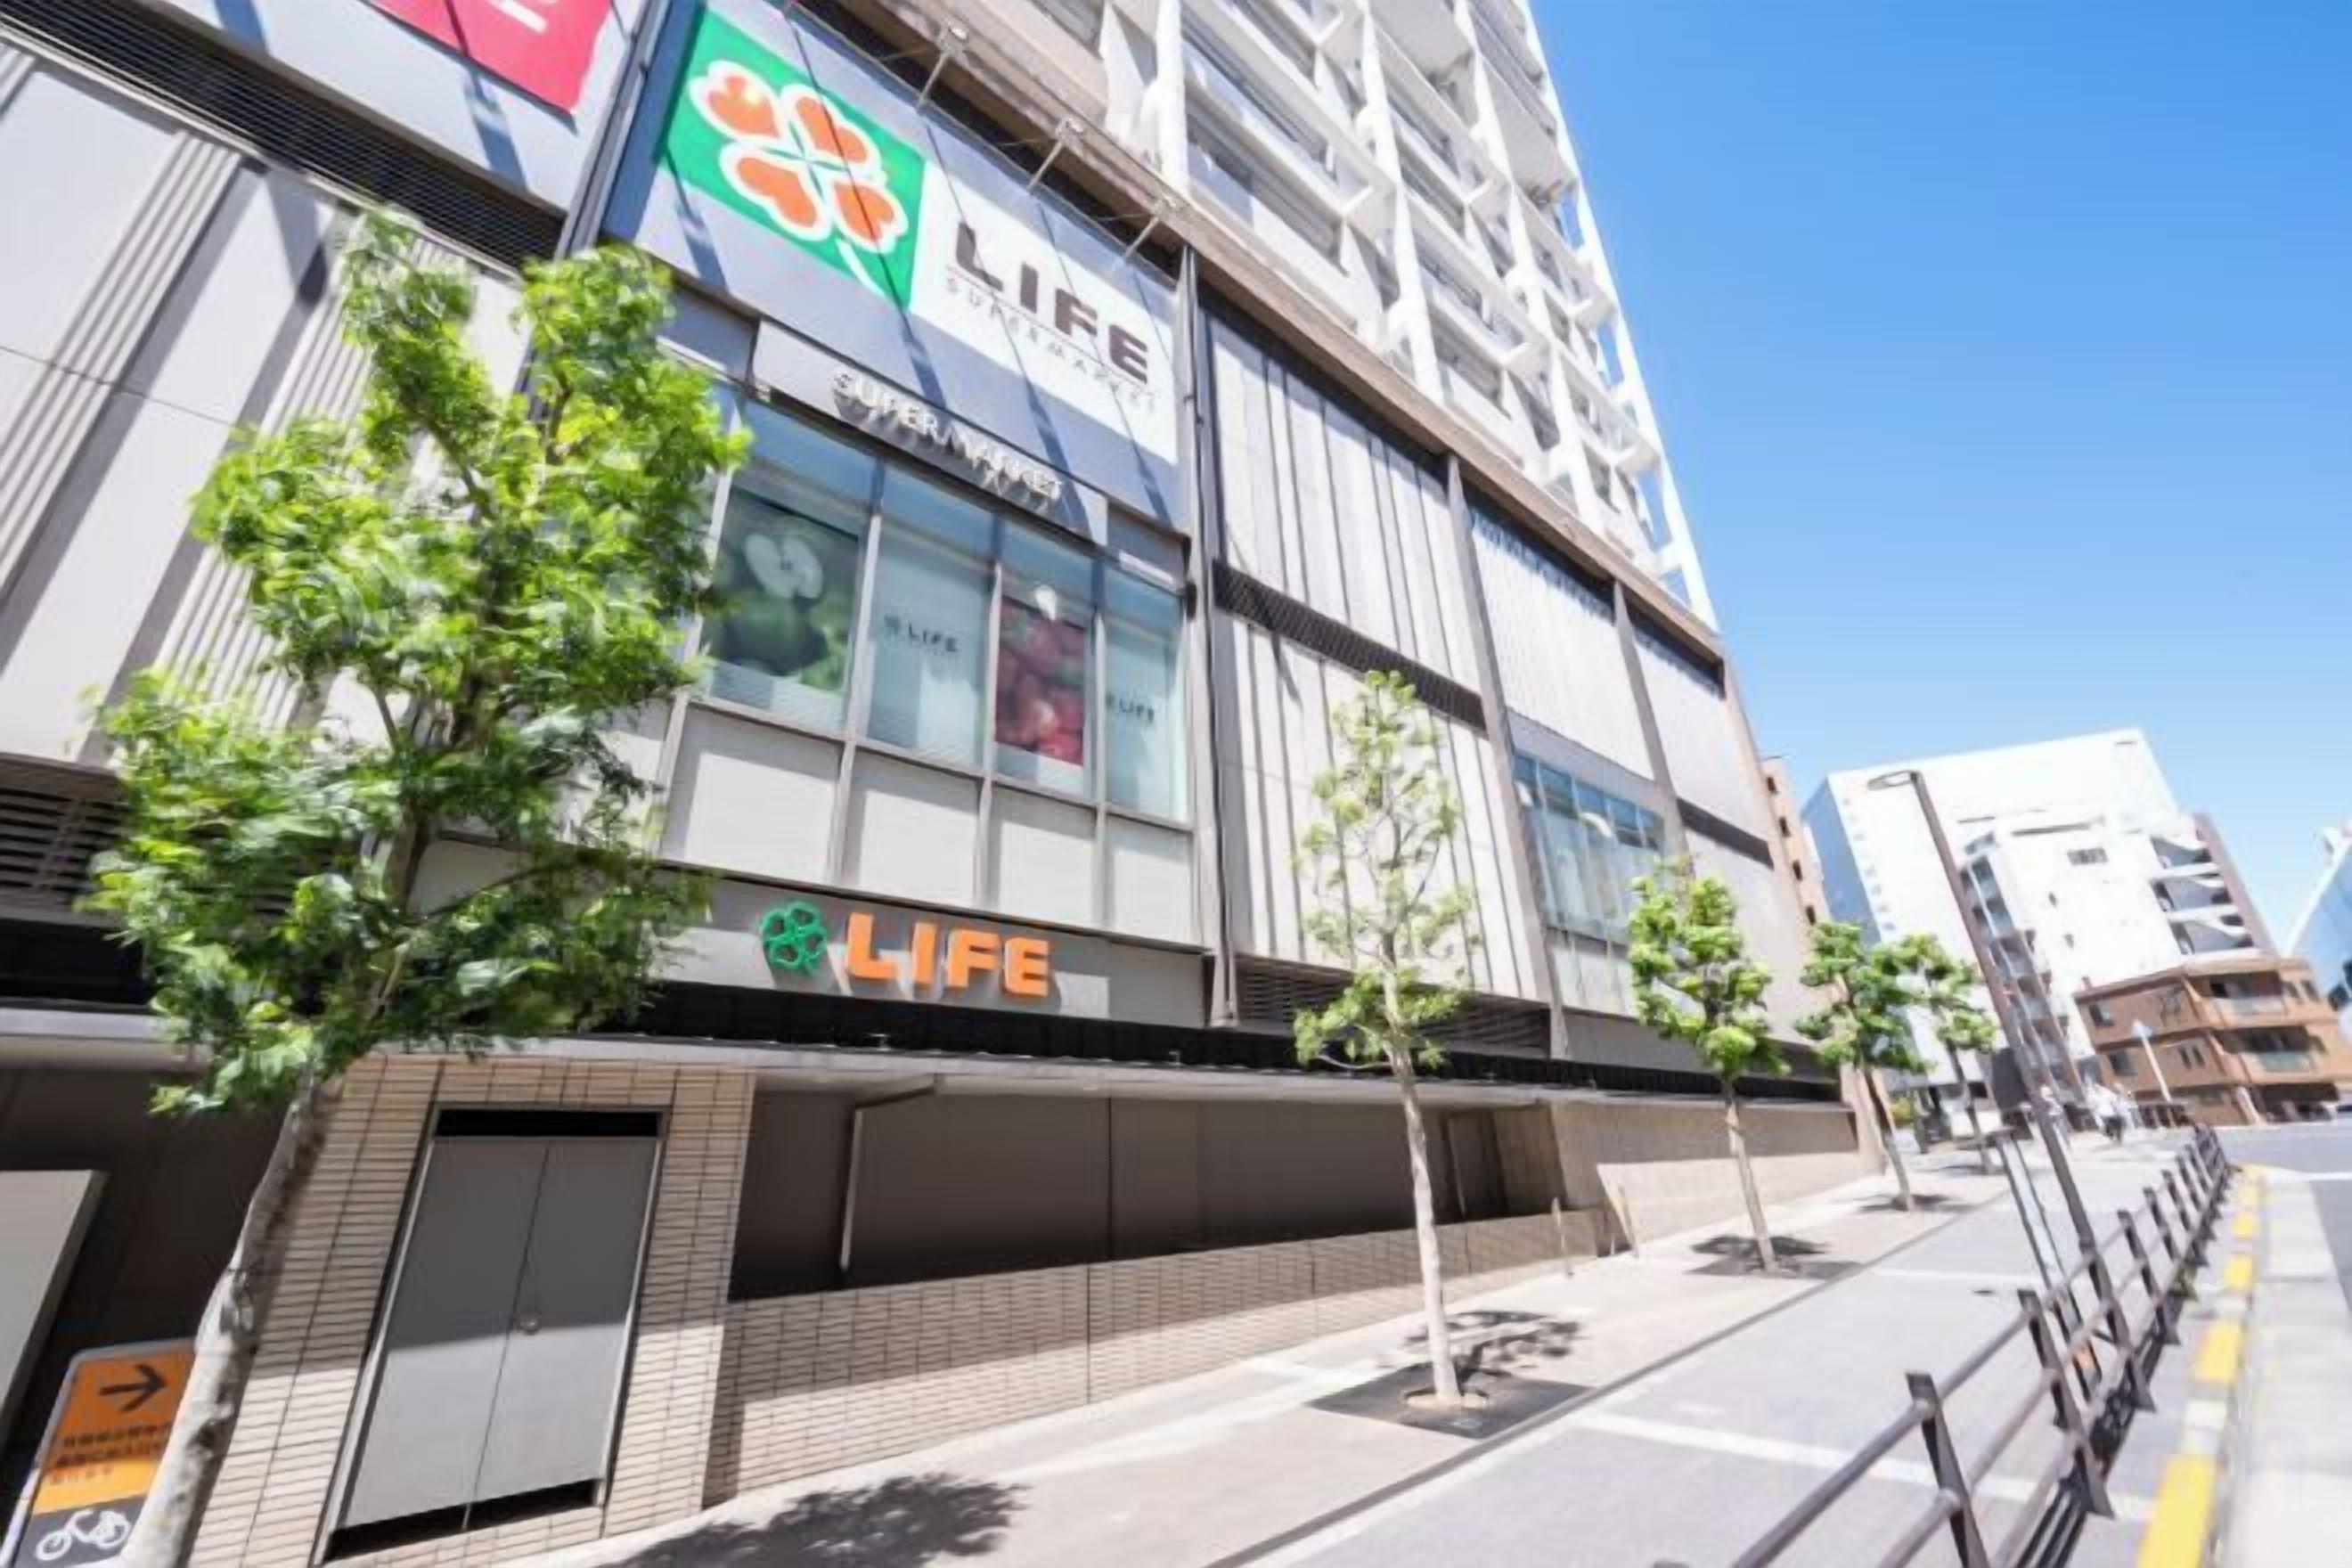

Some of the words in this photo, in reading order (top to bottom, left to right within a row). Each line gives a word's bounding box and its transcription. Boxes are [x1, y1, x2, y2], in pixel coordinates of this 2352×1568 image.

[955, 222, 1147, 384] LIFE
[908, 623, 957, 652] LIFE
[1119, 698, 1155, 722] LIFE
[847, 911, 1049, 997] LIFE
